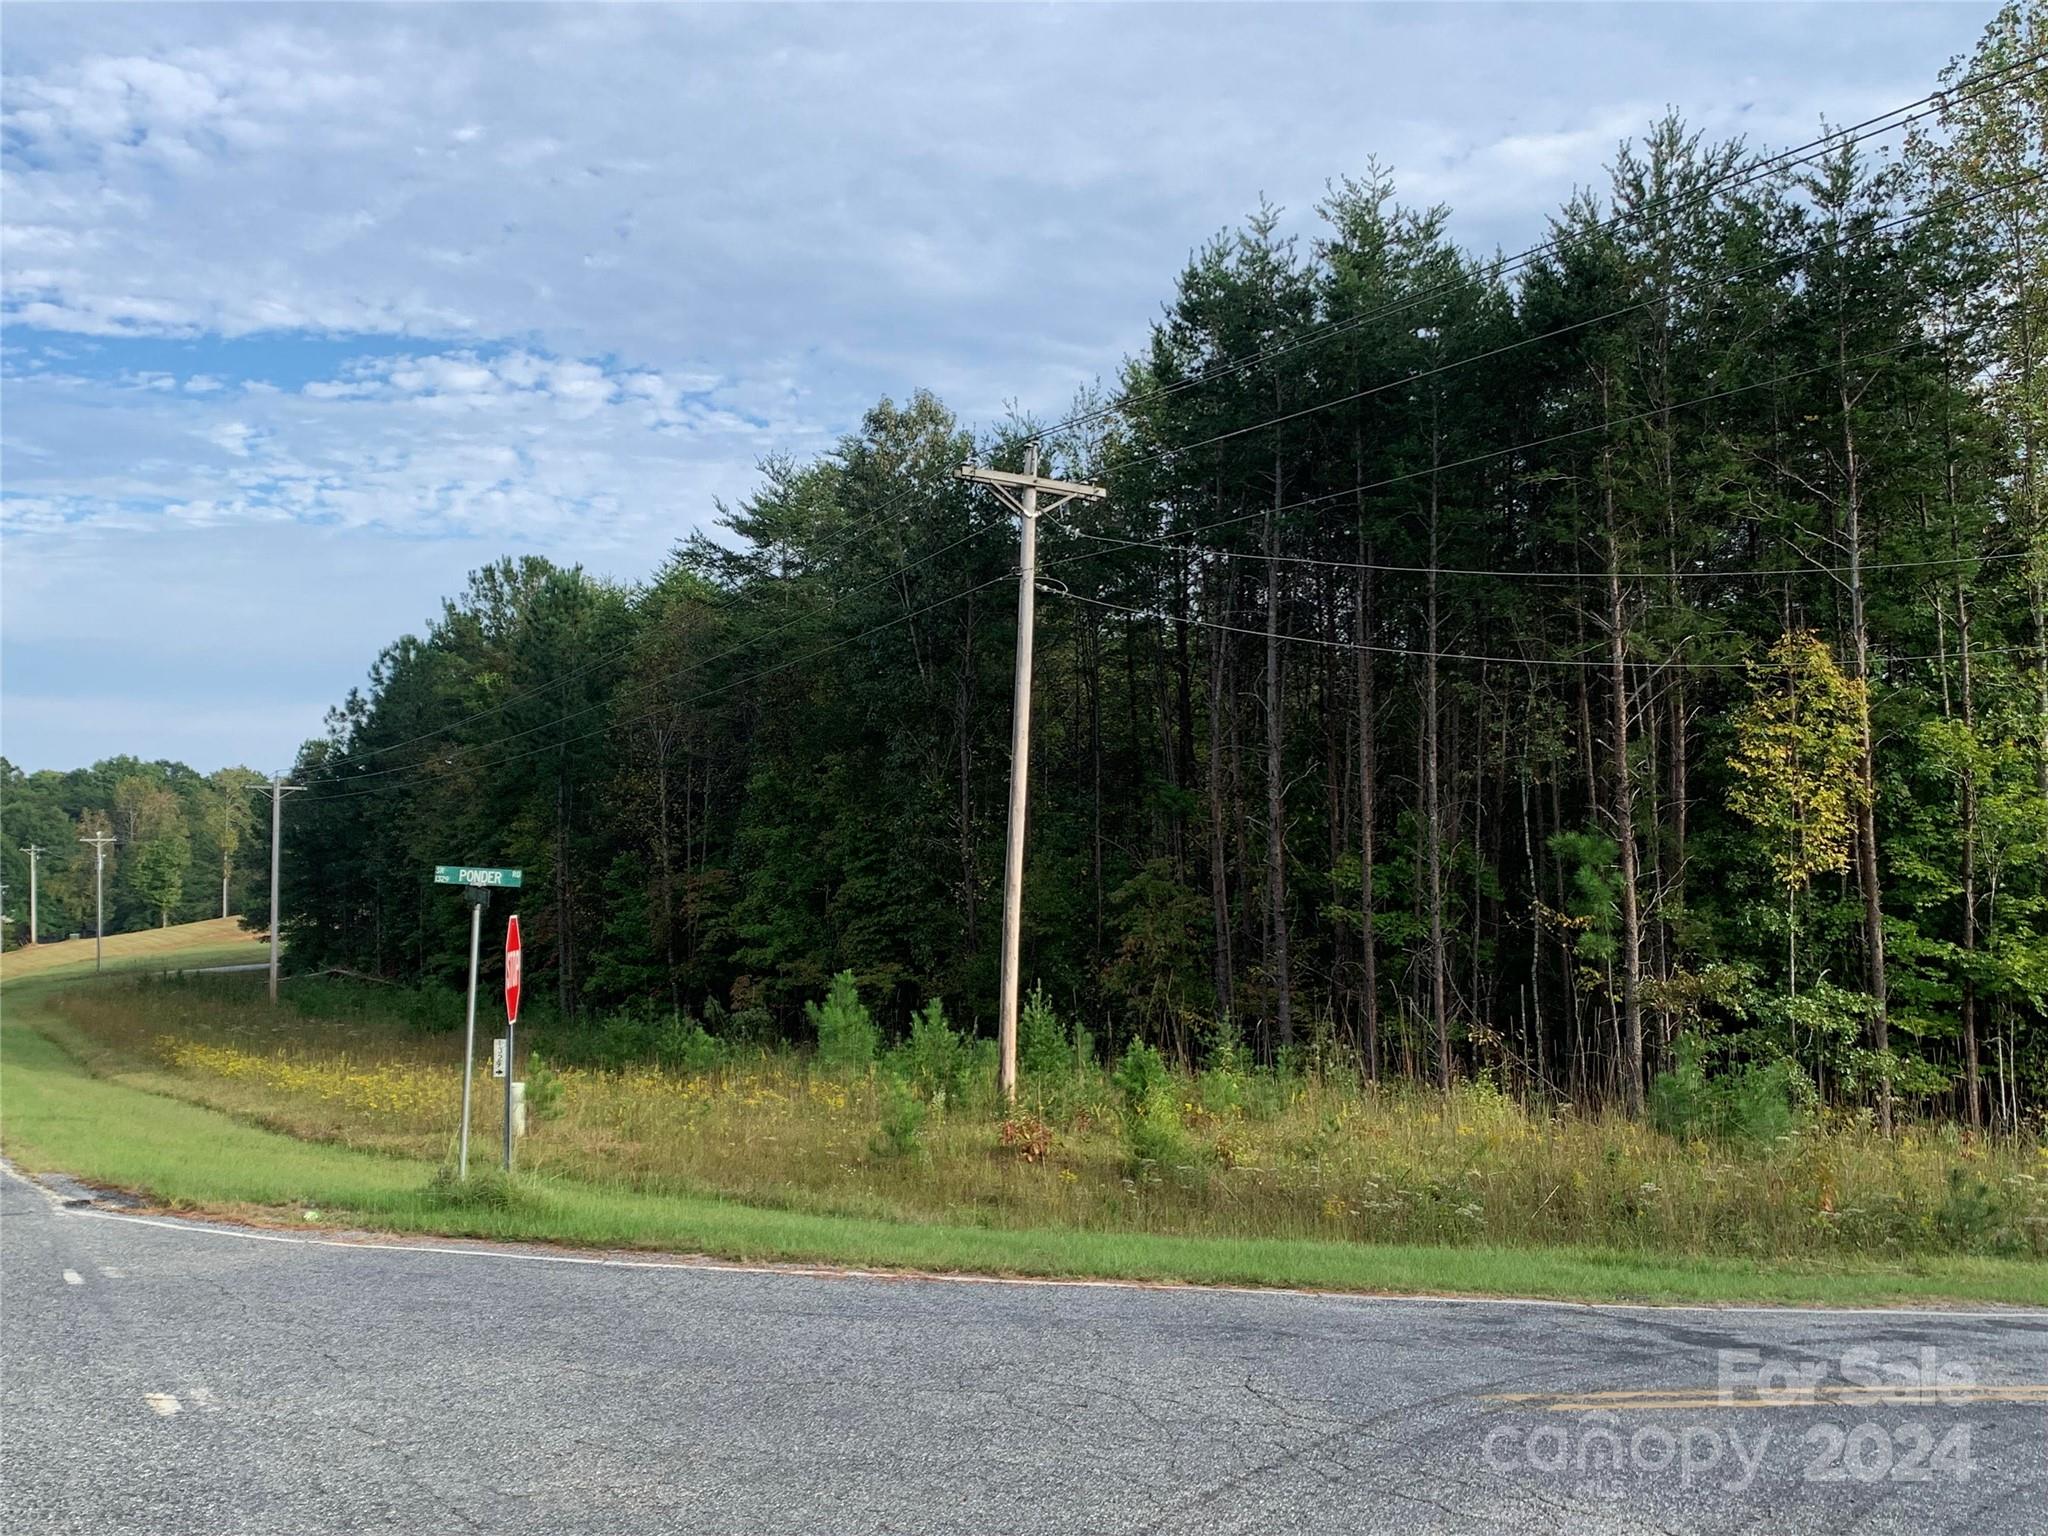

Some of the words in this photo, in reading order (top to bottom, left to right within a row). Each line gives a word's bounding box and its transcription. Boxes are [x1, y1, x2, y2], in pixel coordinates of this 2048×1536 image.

[458, 869, 502, 884] PONDER
[512, 870, 522, 878] RD
[505, 950, 521, 989] STOP
